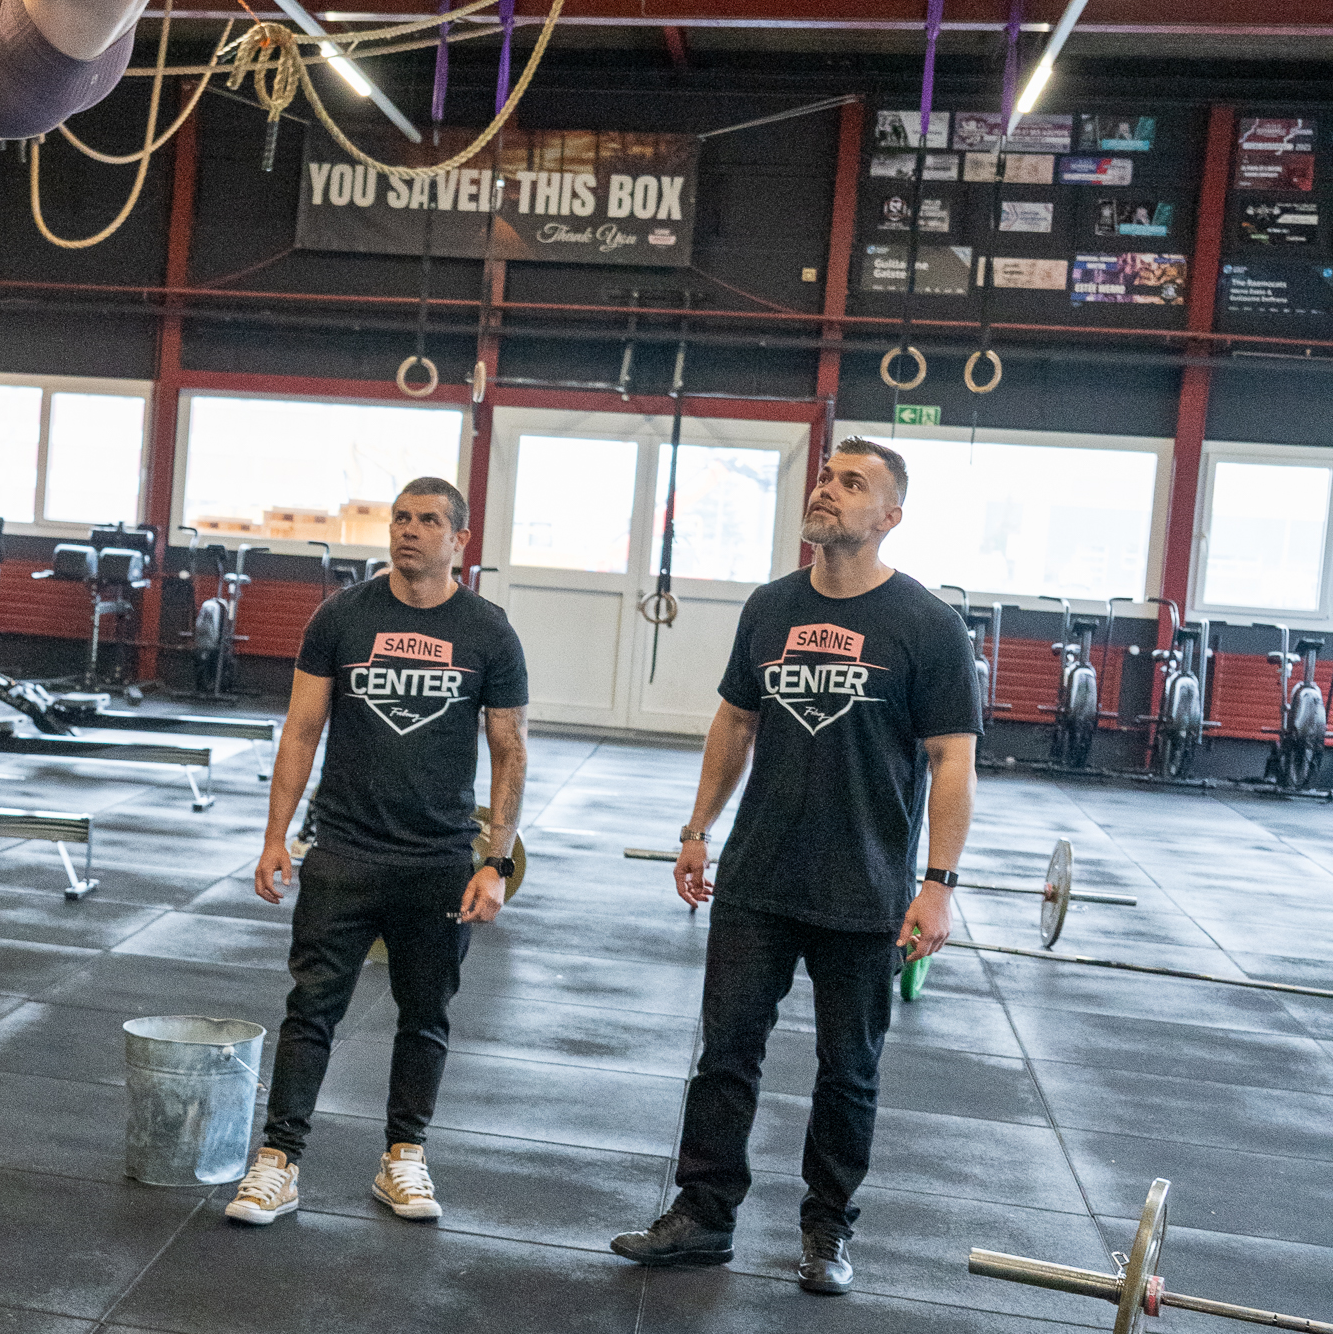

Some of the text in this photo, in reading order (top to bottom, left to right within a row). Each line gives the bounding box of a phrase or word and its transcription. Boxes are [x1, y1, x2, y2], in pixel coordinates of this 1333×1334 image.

[309, 163, 377, 207] YOU
[516, 171, 597, 216] THIS
[608, 174, 684, 220] BOX
[536, 223, 593, 243] Thank
[595, 223, 637, 252] You
[383, 638, 443, 658] SARINE
[796, 629, 854, 651] SARINE
[350, 667, 463, 697] CENTER
[764, 664, 869, 696] CENTER
